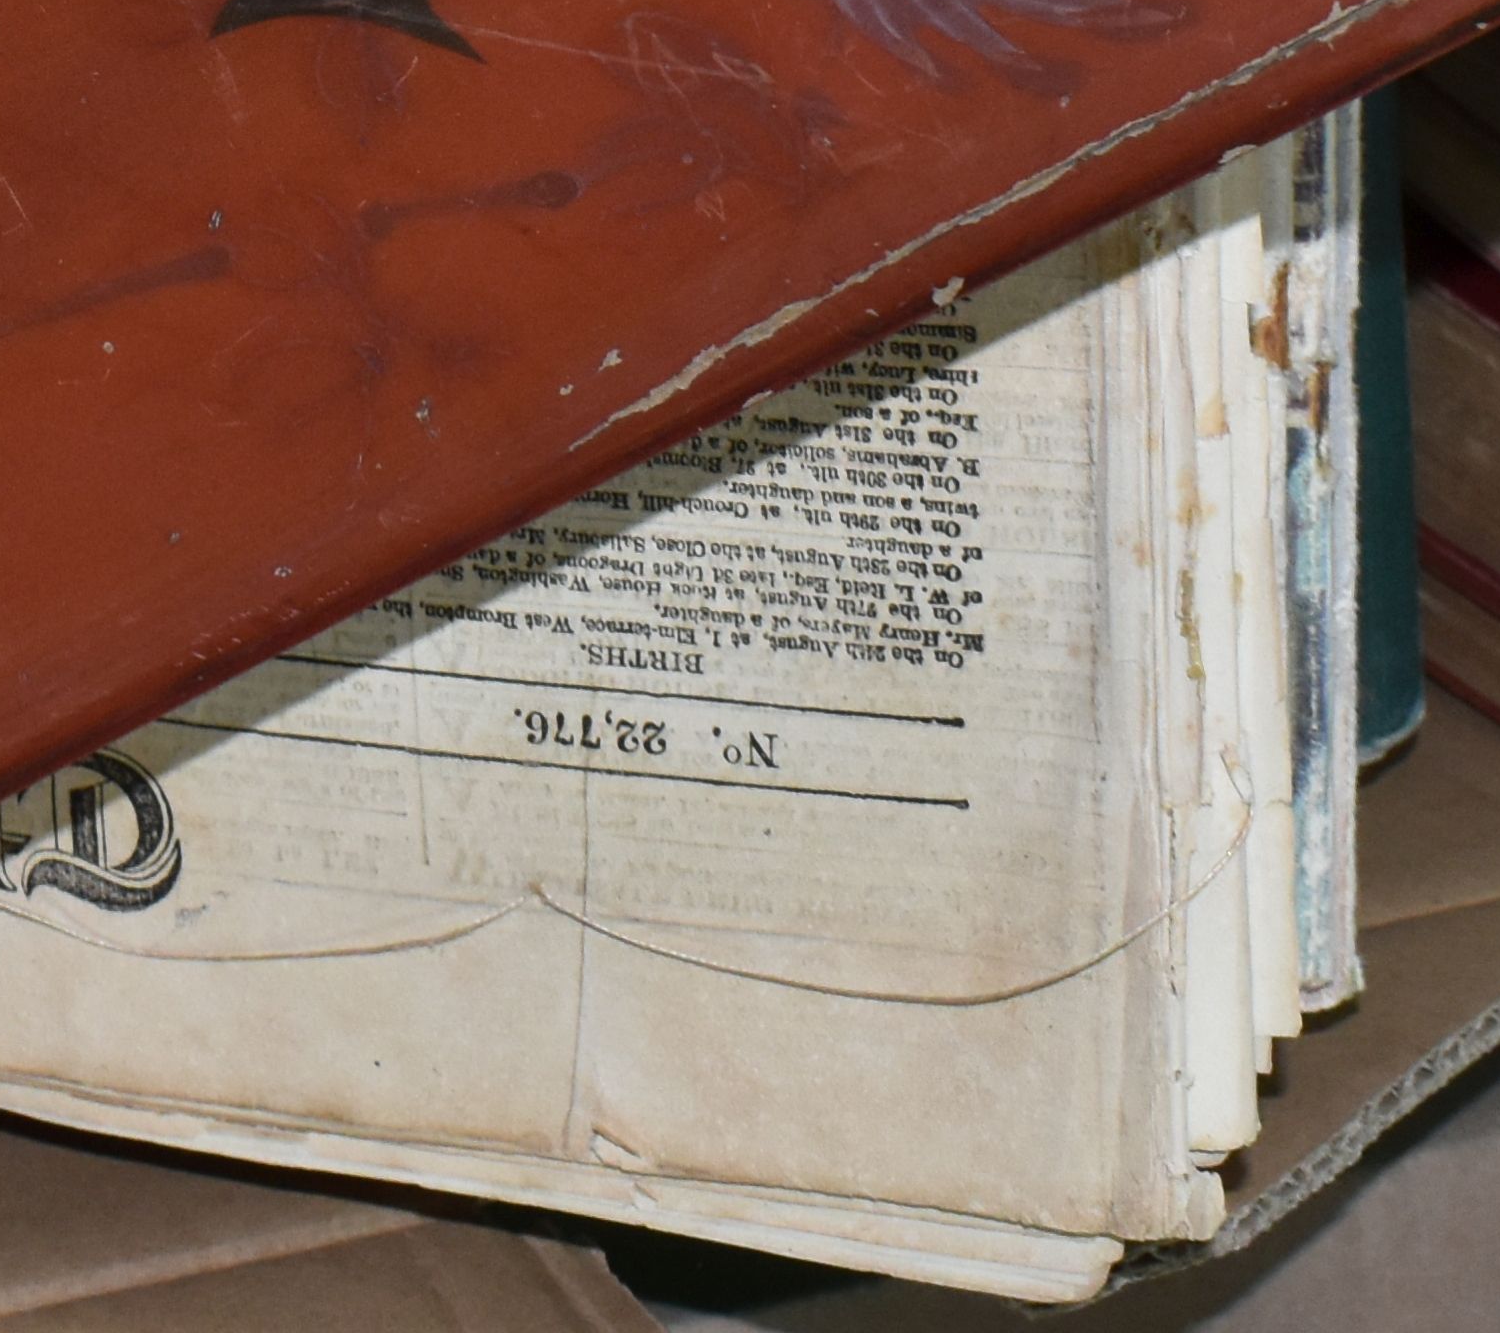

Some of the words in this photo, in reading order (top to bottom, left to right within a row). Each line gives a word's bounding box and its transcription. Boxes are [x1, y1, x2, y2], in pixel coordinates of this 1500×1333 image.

[722, 479, 814, 503] daughter.
[820, 491, 857, 508] and
[862, 493, 895, 510] son
[900, 497, 913, 511] a
[920, 495, 979, 520] twins,
[580, 642, 704, 675] BIRTHS.
[512, 706, 668, 758] 22,776.
